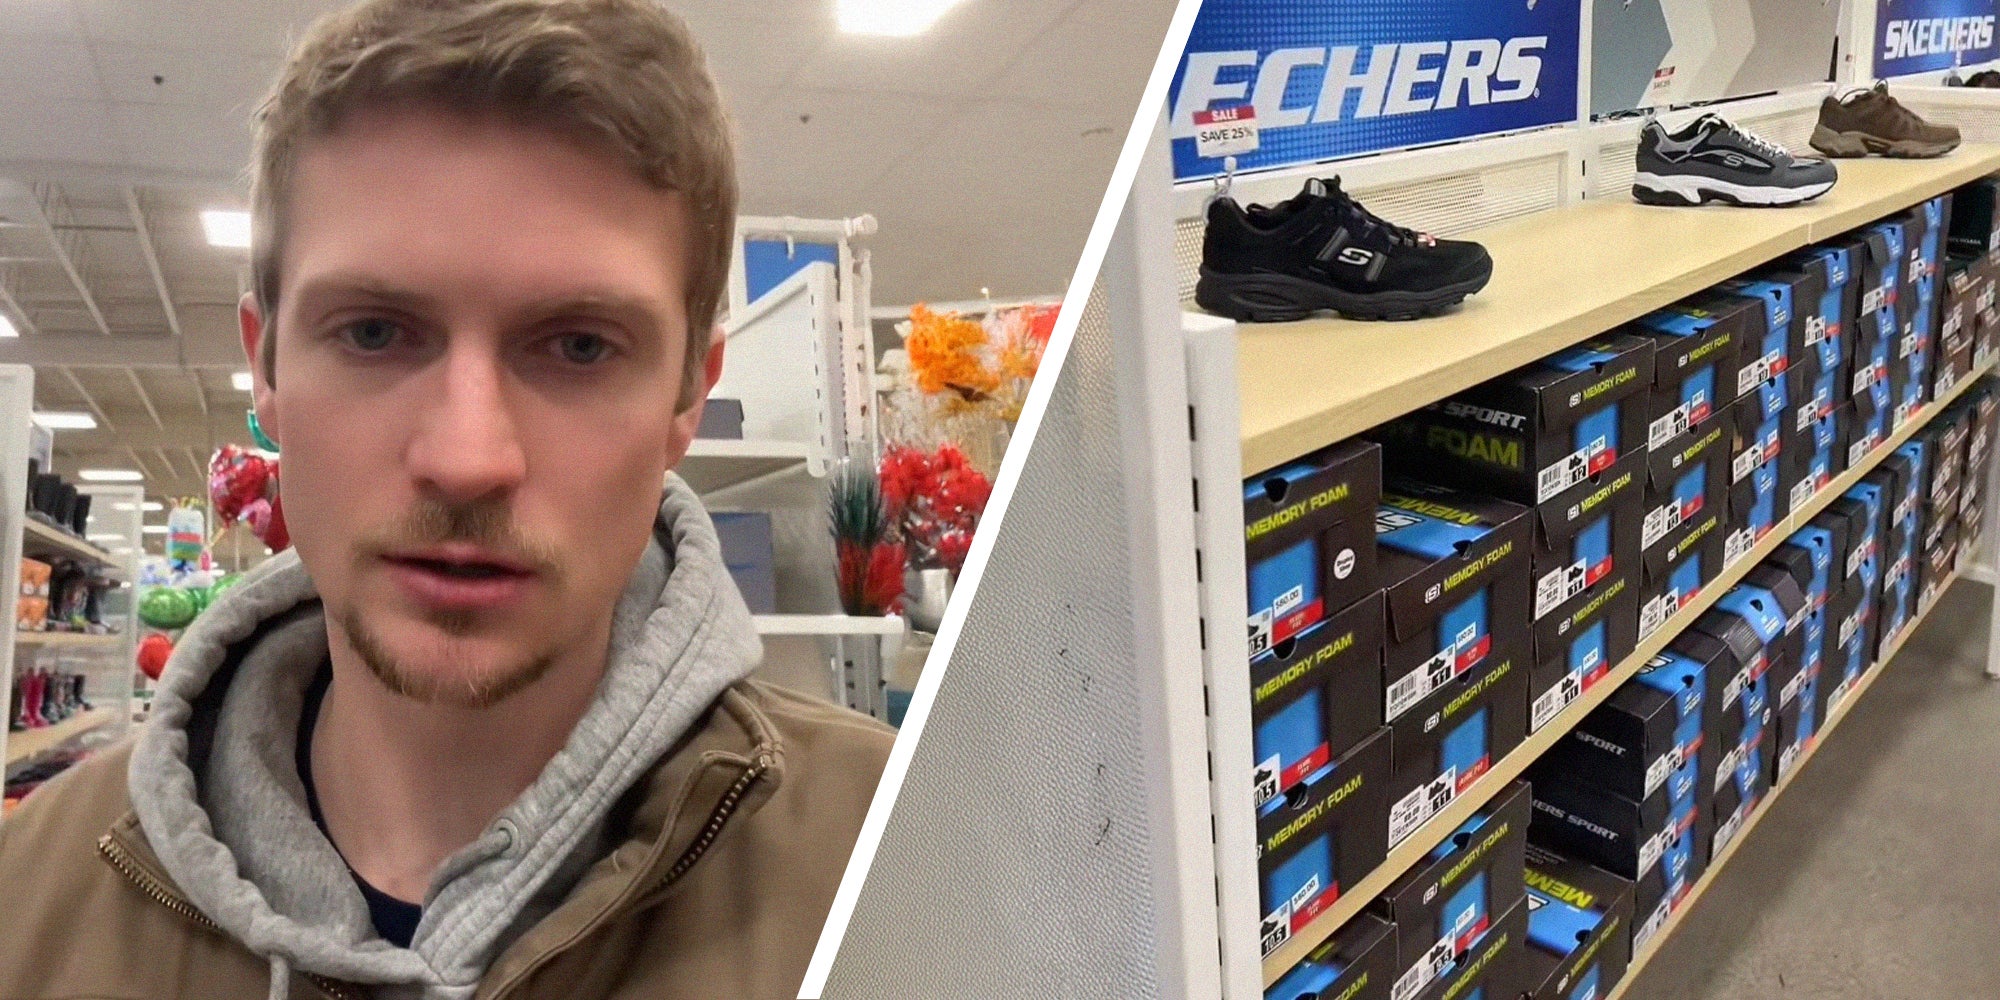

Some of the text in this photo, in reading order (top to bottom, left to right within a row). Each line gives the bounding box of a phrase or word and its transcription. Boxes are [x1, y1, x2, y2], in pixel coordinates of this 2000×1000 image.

[1884, 15, 1996, 60] SKECHERS
[1171, 36, 1547, 140] ECHERS
[1200, 127, 1254, 143] SAVE 25%
[1211, 108, 1239, 122] SALE
[1714, 333, 1731, 348] FOAM
[1583, 376, 1614, 401] MEMORY
[1615, 366, 1638, 384] FOAM
[1444, 401, 1527, 430] SPORT
[1707, 427, 1722, 444] FOAM
[1427, 426, 1520, 469] FOAM
[1246, 483, 1349, 541] MEMORY FOAM
[1581, 484, 1612, 513] MEMORY
[1612, 472, 1632, 494] FOAM
[1701, 515, 1717, 533] FOAM
[1444, 562, 1485, 592] MEMORY
[1486, 540, 1513, 565] FOAM
[1573, 598, 1603, 625] MEMORY
[1603, 578, 1625, 601] FOAM
[1255, 632, 1354, 702] MEMORY FOAM
[1443, 682, 1484, 718] MEMORY
[1485, 659, 1511, 688] FOAM
[1267, 773, 1364, 851] MEMORY FOAM
[1568, 814, 1620, 842] SPORT
[1441, 846, 1482, 888] MEMORY
[1483, 822, 1509, 850] FOAM
[1335, 971, 1369, 1000] OAM
[1442, 931, 1508, 1000] MEMORY FOAM
